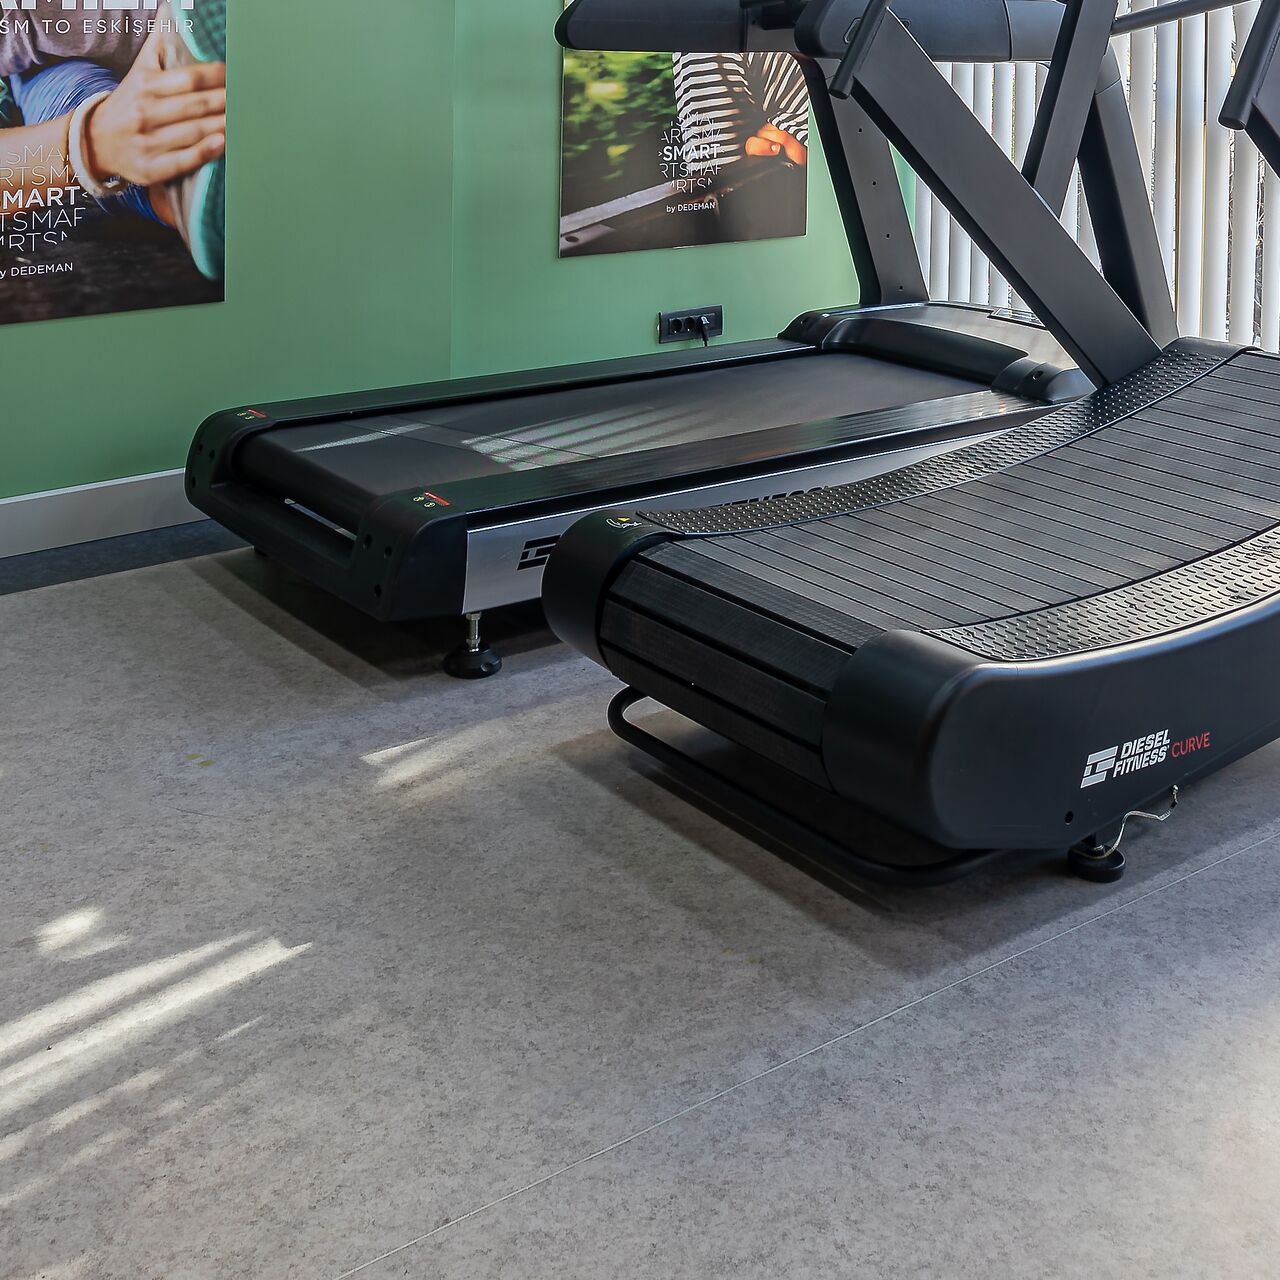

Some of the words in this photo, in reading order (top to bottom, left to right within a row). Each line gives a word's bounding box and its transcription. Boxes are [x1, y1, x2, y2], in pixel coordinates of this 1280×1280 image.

[41, 19, 71, 35] TO
[82, 16, 194, 37] ESKİŞEHİR
[666, 204, 676, 213] by
[677, 201, 716, 212] DEDEMAN
[11, 262, 73, 277] DEDEMAN
[1113, 745, 1169, 778] FITNESS
[1171, 731, 1211, 758] CURVE
[1120, 729, 1170, 759] DIESEL
